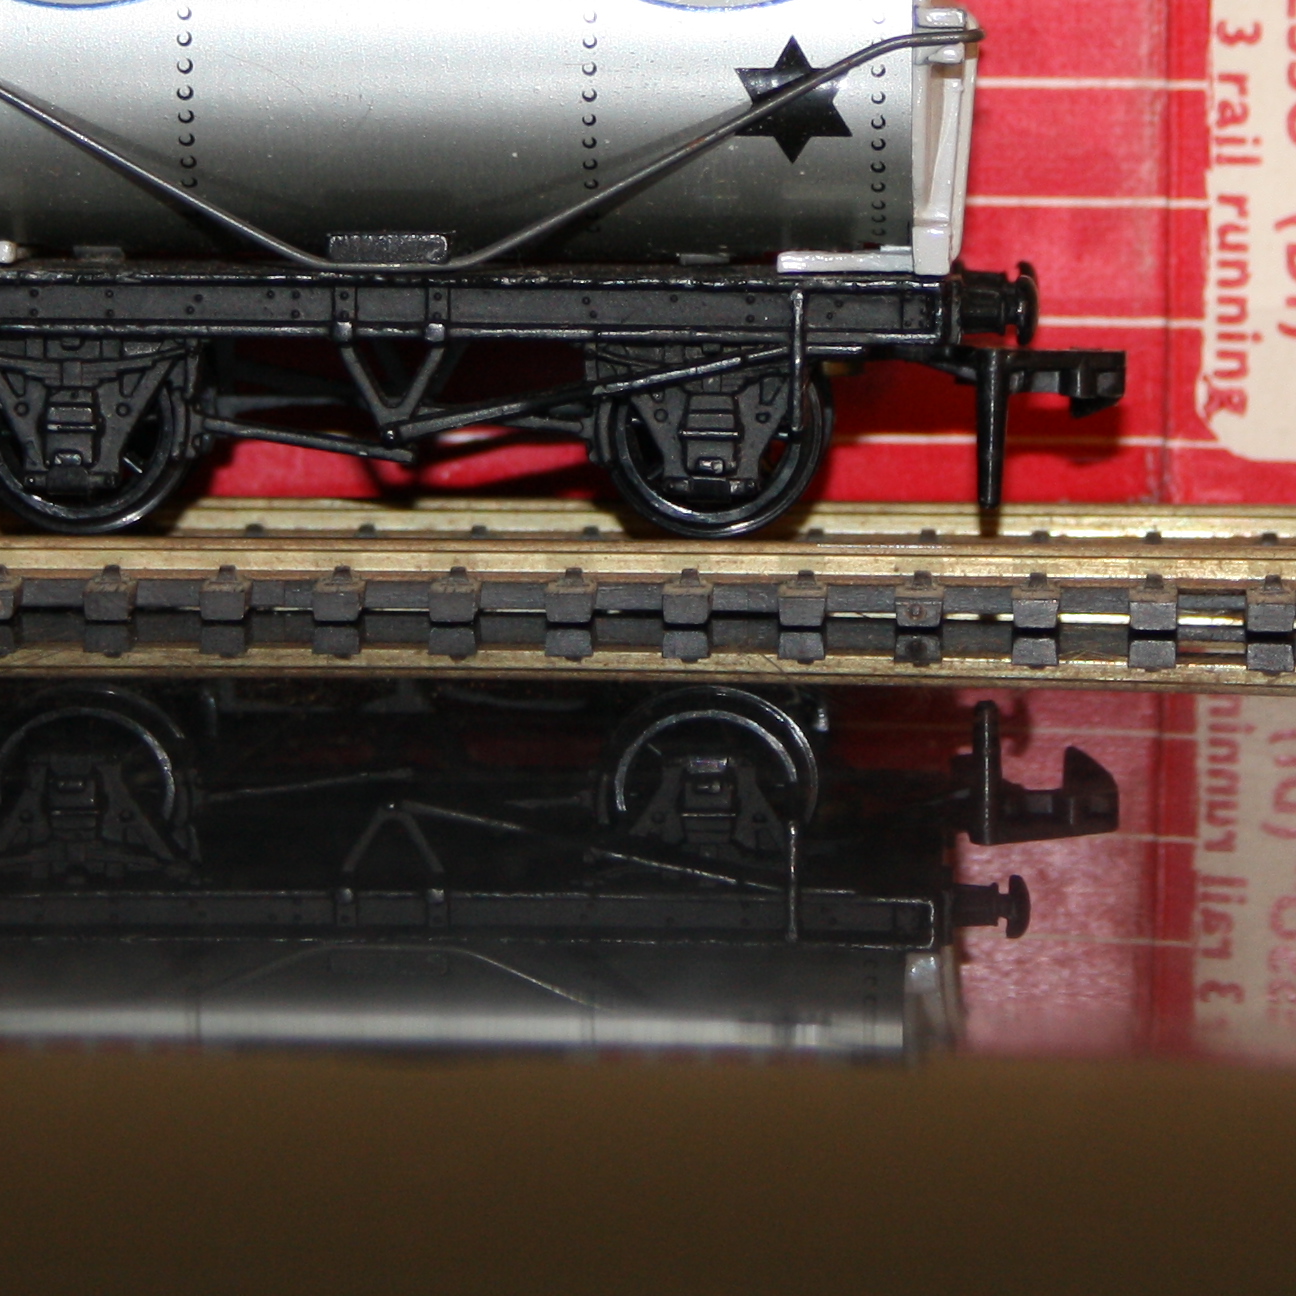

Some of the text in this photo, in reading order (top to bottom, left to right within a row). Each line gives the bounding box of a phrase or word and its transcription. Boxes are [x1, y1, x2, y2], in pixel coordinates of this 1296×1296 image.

[1216, 19, 1262, 47] 3
[1214, 72, 1262, 166] rail
[1204, 193, 1263, 421] running
